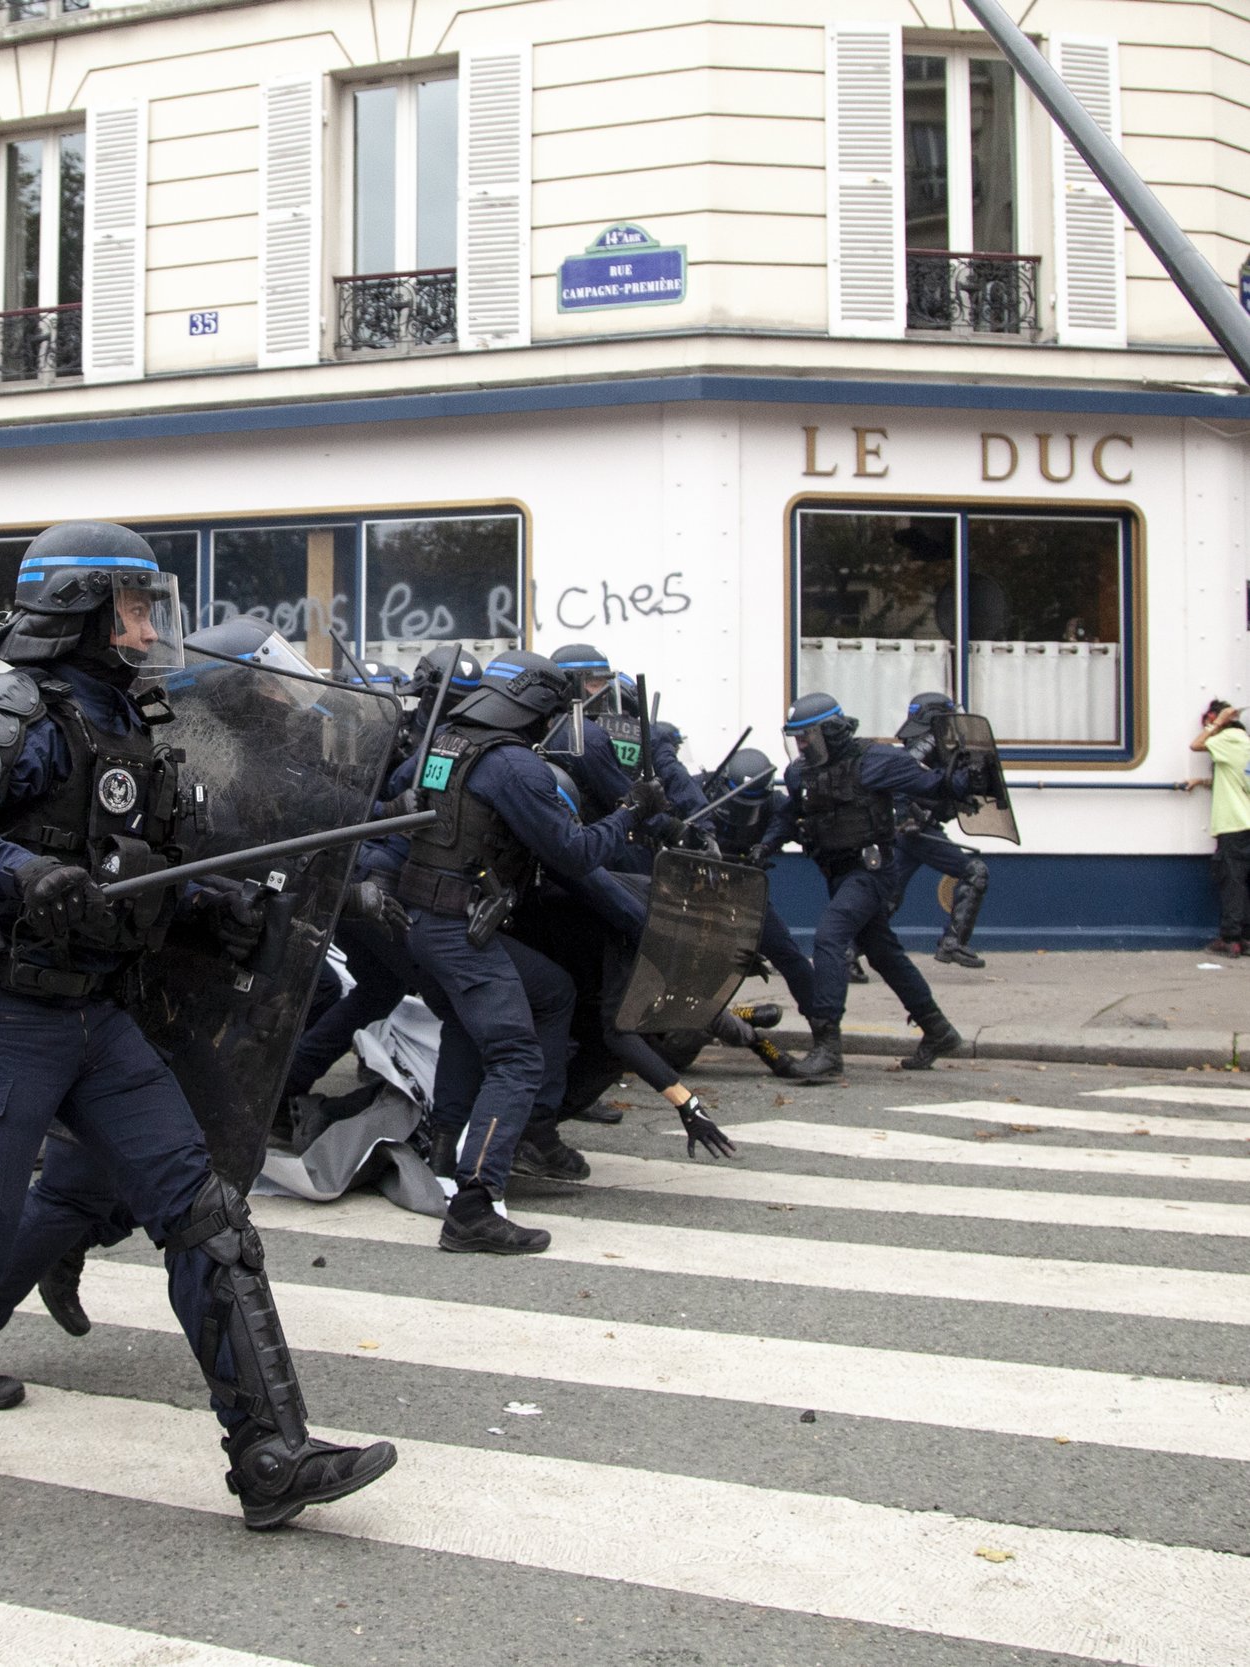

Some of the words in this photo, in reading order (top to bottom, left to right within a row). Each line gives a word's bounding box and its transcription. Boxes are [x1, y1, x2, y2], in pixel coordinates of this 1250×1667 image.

[609, 264, 633, 277] RUE
[562, 276, 682, 300] CAMPAGNE-PREMIÈRE
[191, 312, 217, 334] 35
[801, 425, 890, 479] LE
[979, 432, 1134, 486] DUC
[379, 581, 454, 641] les
[595, 716, 641, 737] OLICE
[425, 763, 444, 781] 313
